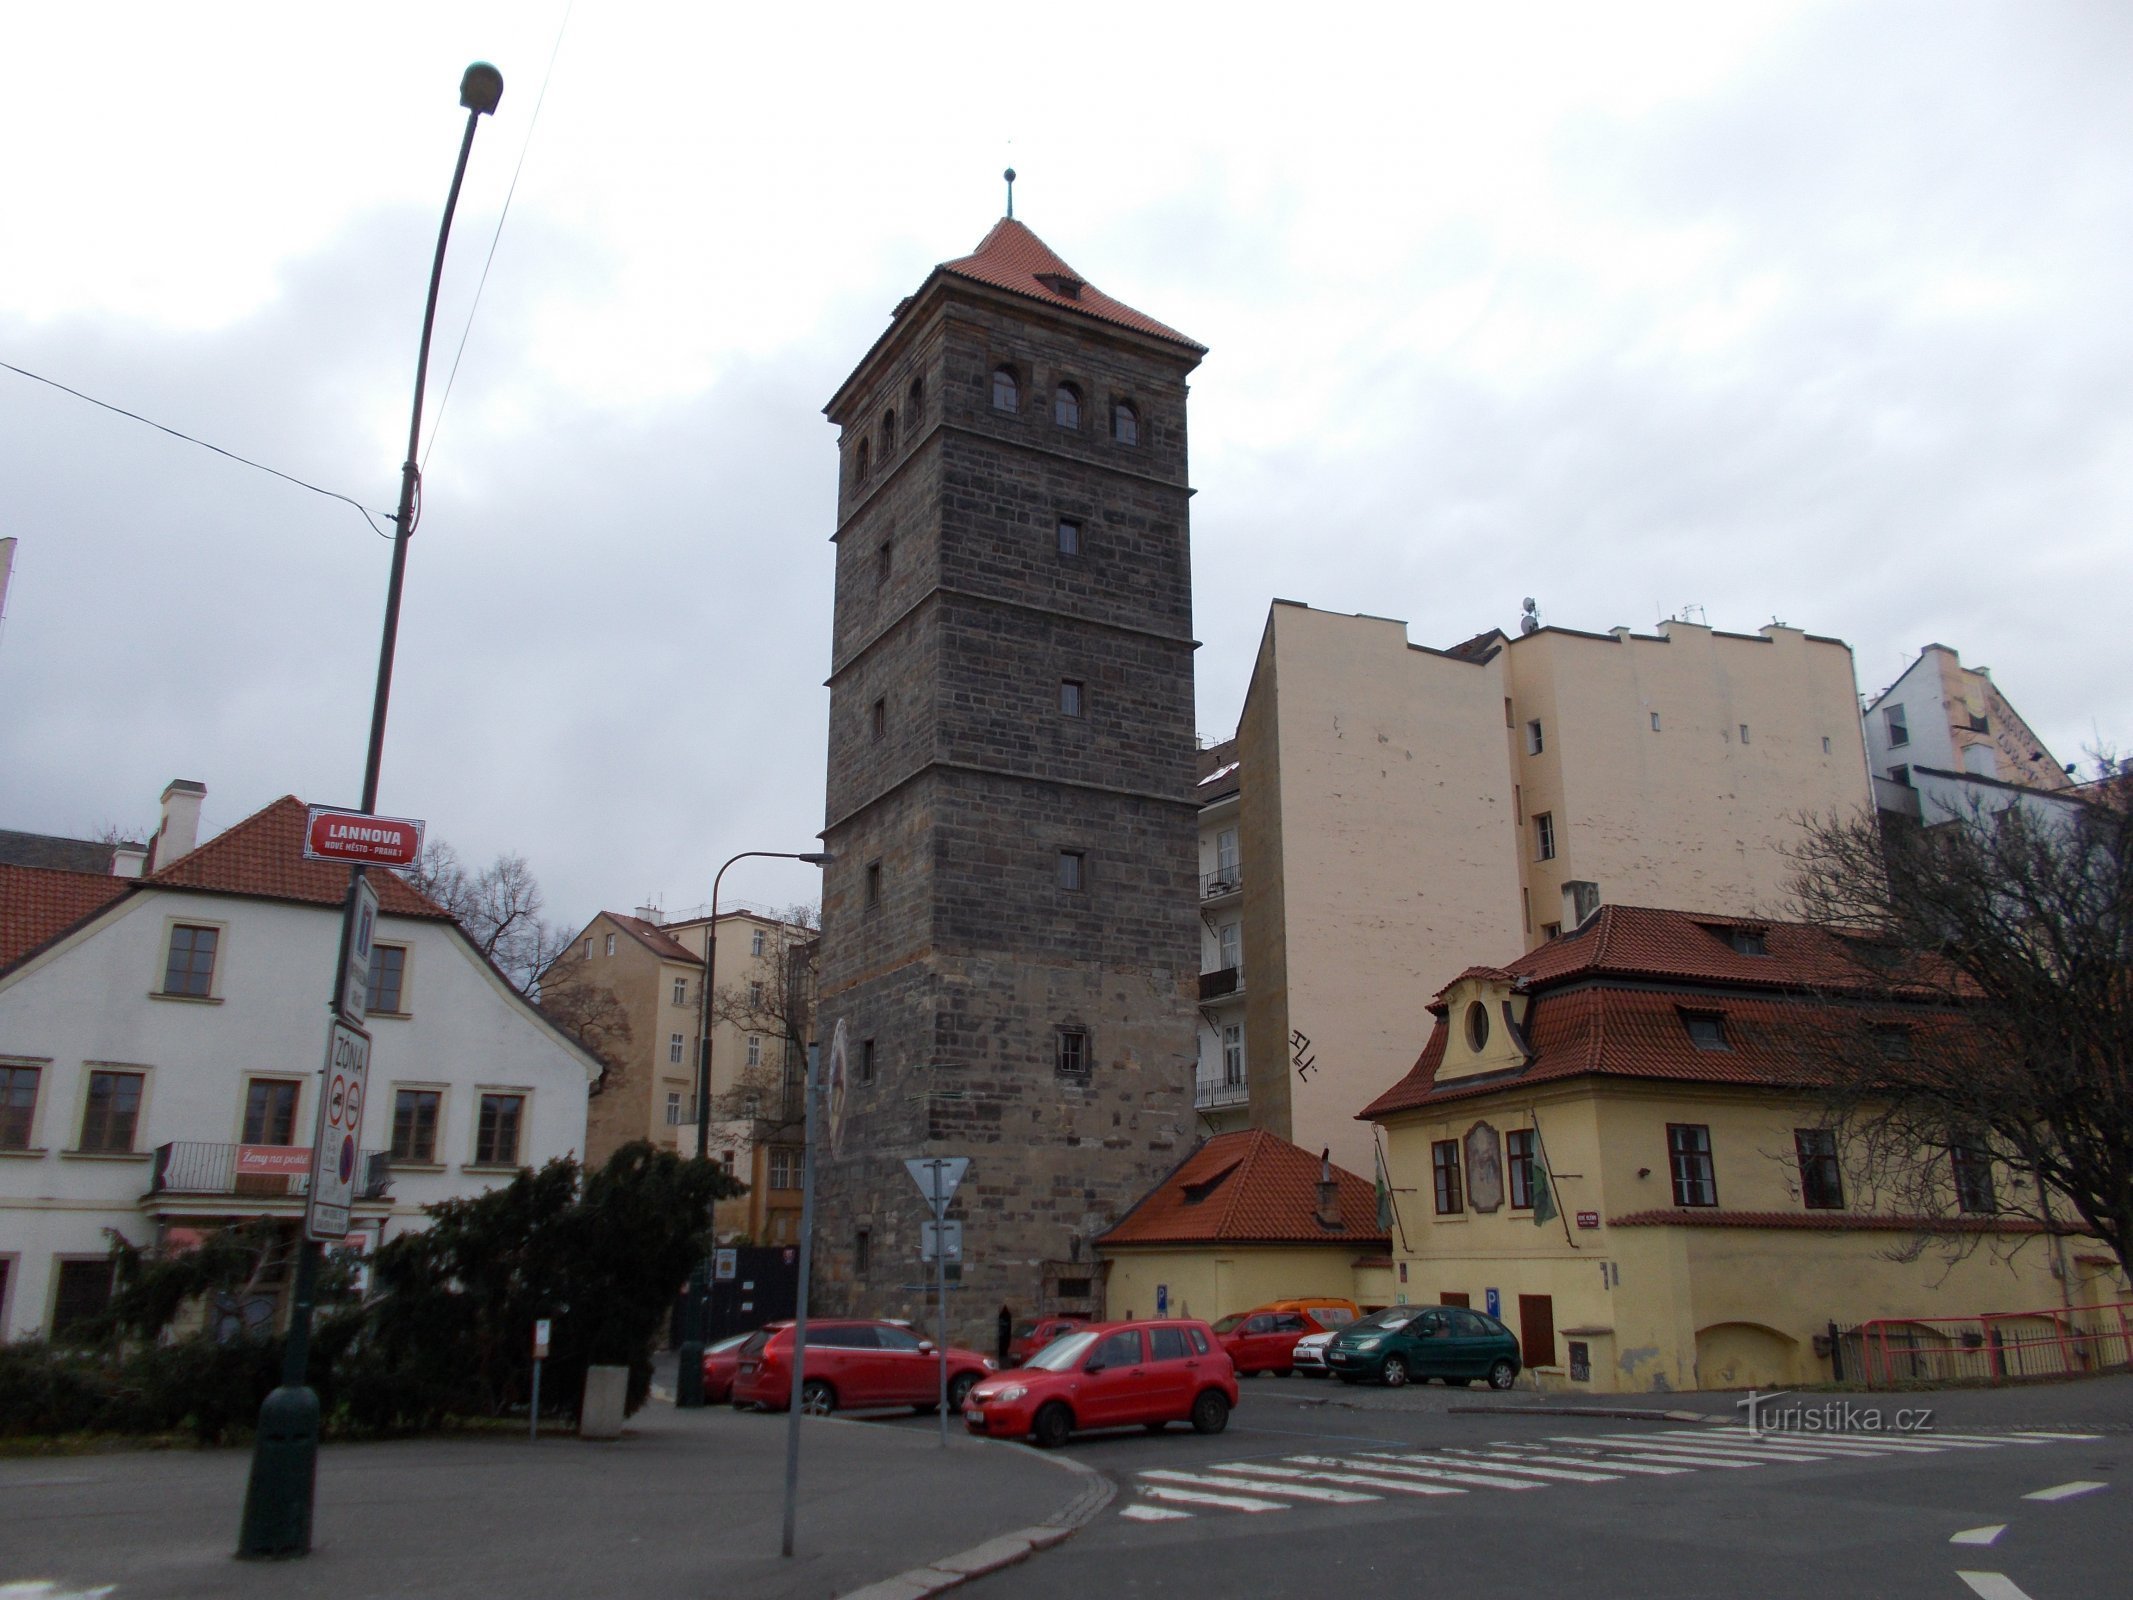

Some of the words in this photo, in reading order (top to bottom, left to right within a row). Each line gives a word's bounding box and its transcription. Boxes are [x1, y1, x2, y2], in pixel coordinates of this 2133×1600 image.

[329, 824, 401, 845] LANNOVA
[324, 841, 343, 850] NOVÉ
[345, 842, 368, 853] MĚSTO
[374, 846, 397, 856] PRAHA
[335, 1034, 363, 1075] ZÓNA
[1487, 1291, 1496, 1309] P
